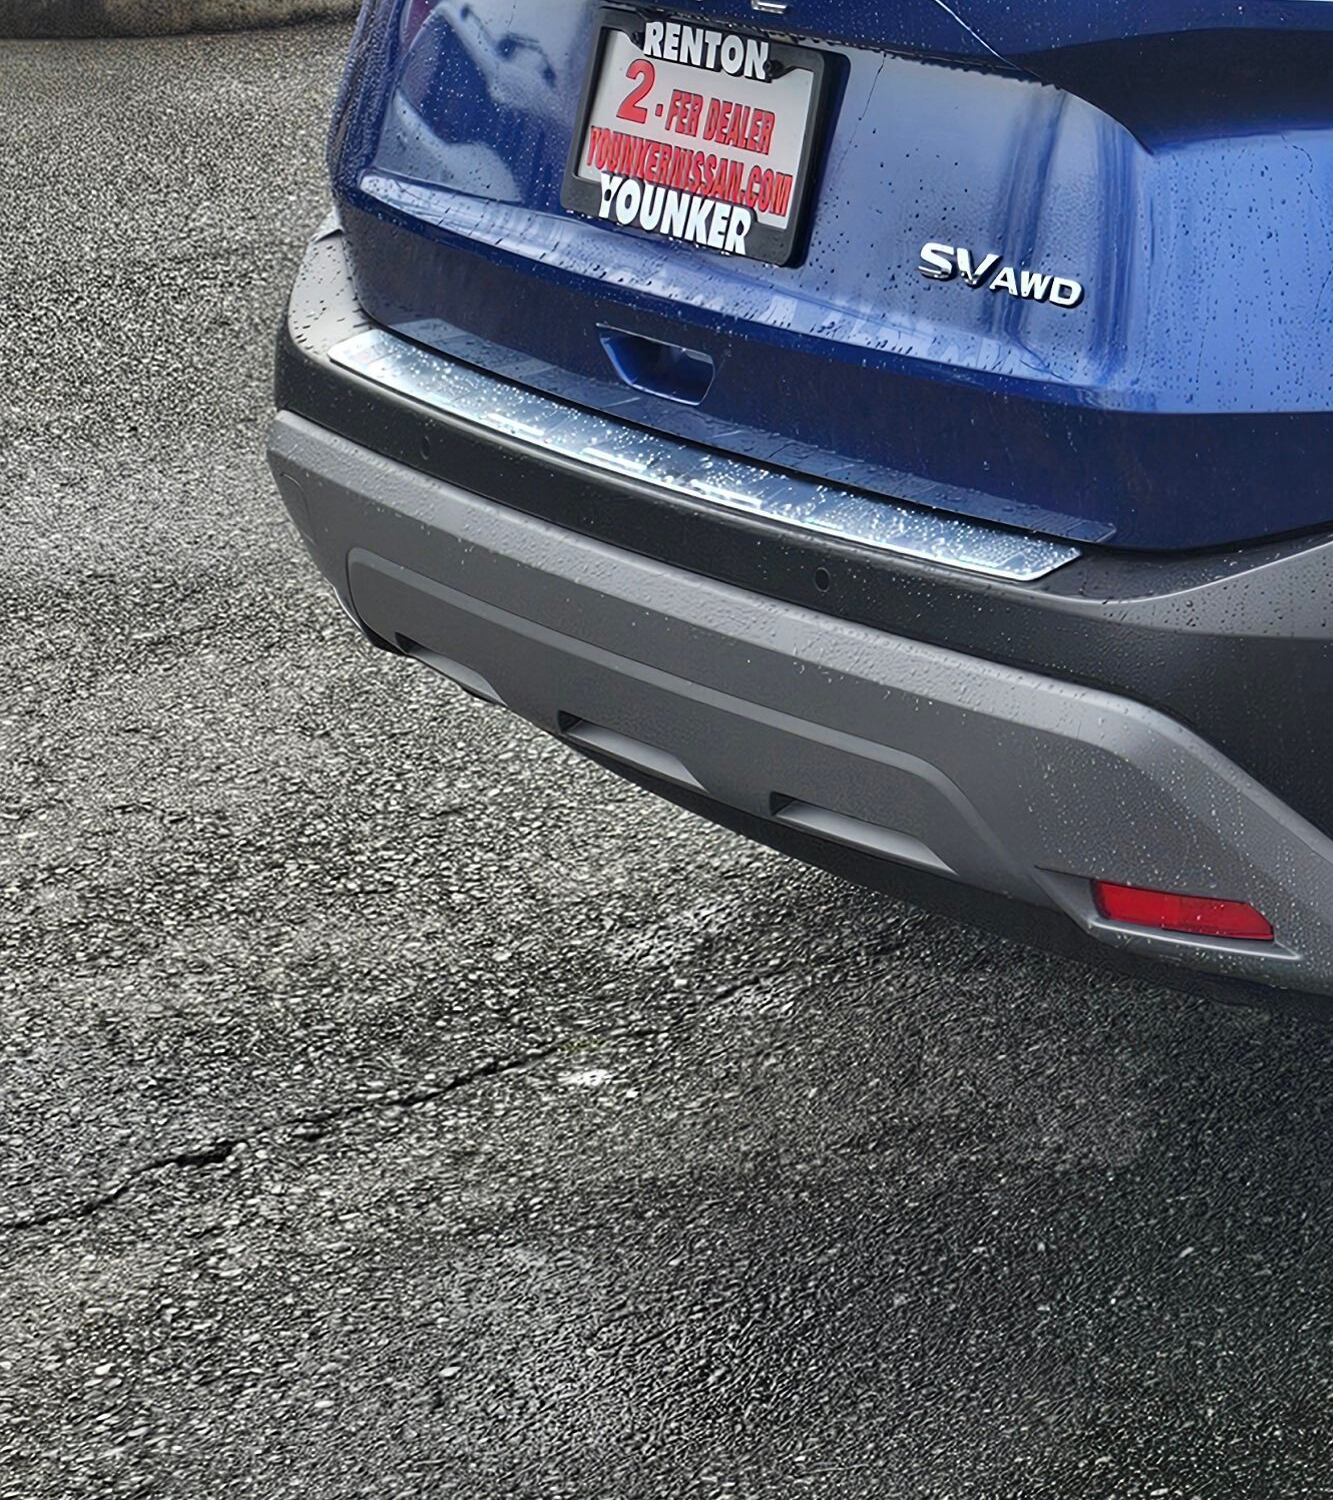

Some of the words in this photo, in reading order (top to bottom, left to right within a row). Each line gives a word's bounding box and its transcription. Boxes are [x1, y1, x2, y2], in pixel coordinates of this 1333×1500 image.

[643, 21, 769, 80] RENTON
[703, 97, 776, 156] DEALER
[587, 126, 793, 217] YOUNKERNISSAN.COM
[599, 173, 753, 255] YOUNKER
[918, 242, 1000, 286] SV
[989, 267, 1083, 307] AWD
